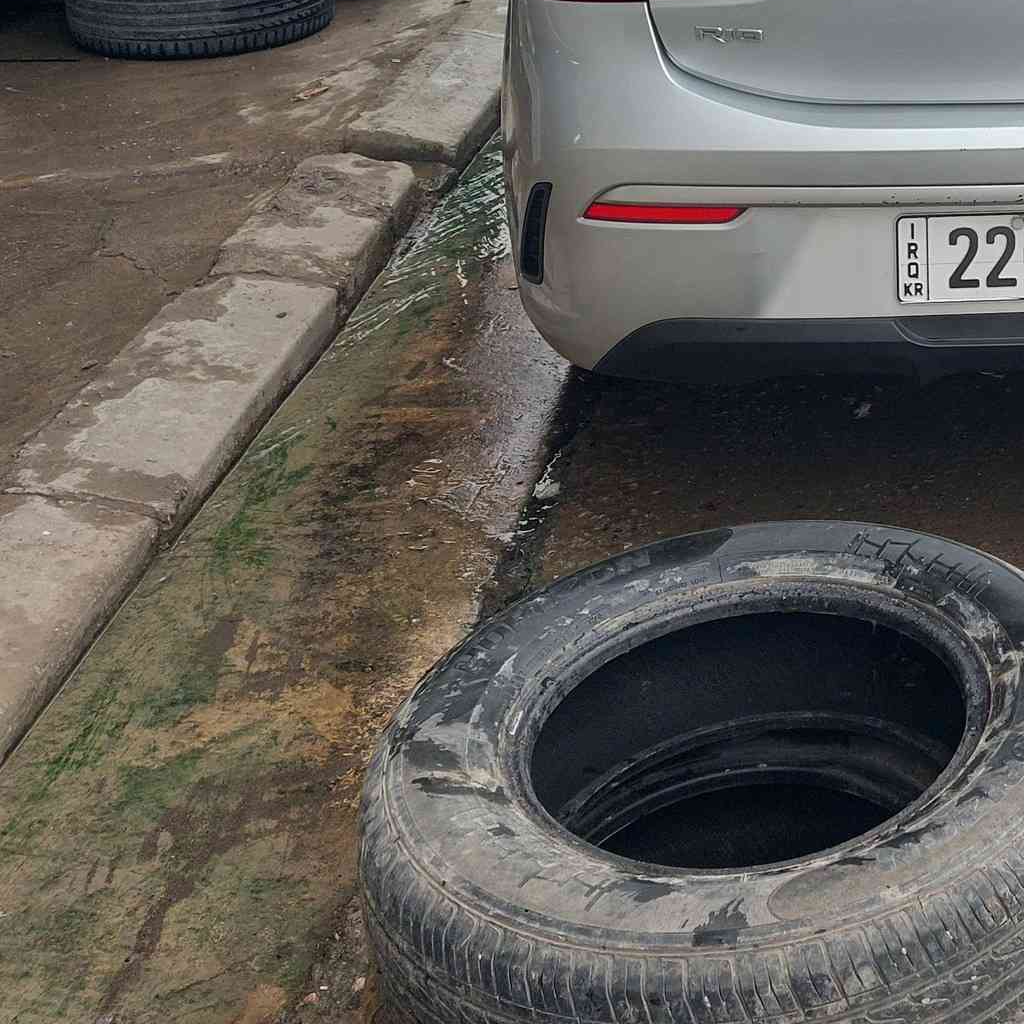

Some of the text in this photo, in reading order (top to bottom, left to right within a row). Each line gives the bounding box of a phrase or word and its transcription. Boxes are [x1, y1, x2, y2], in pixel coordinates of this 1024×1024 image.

[696, 26, 764, 43] RIO
[948, 226, 1018, 289] 22
[904, 282, 923, 297] KR
